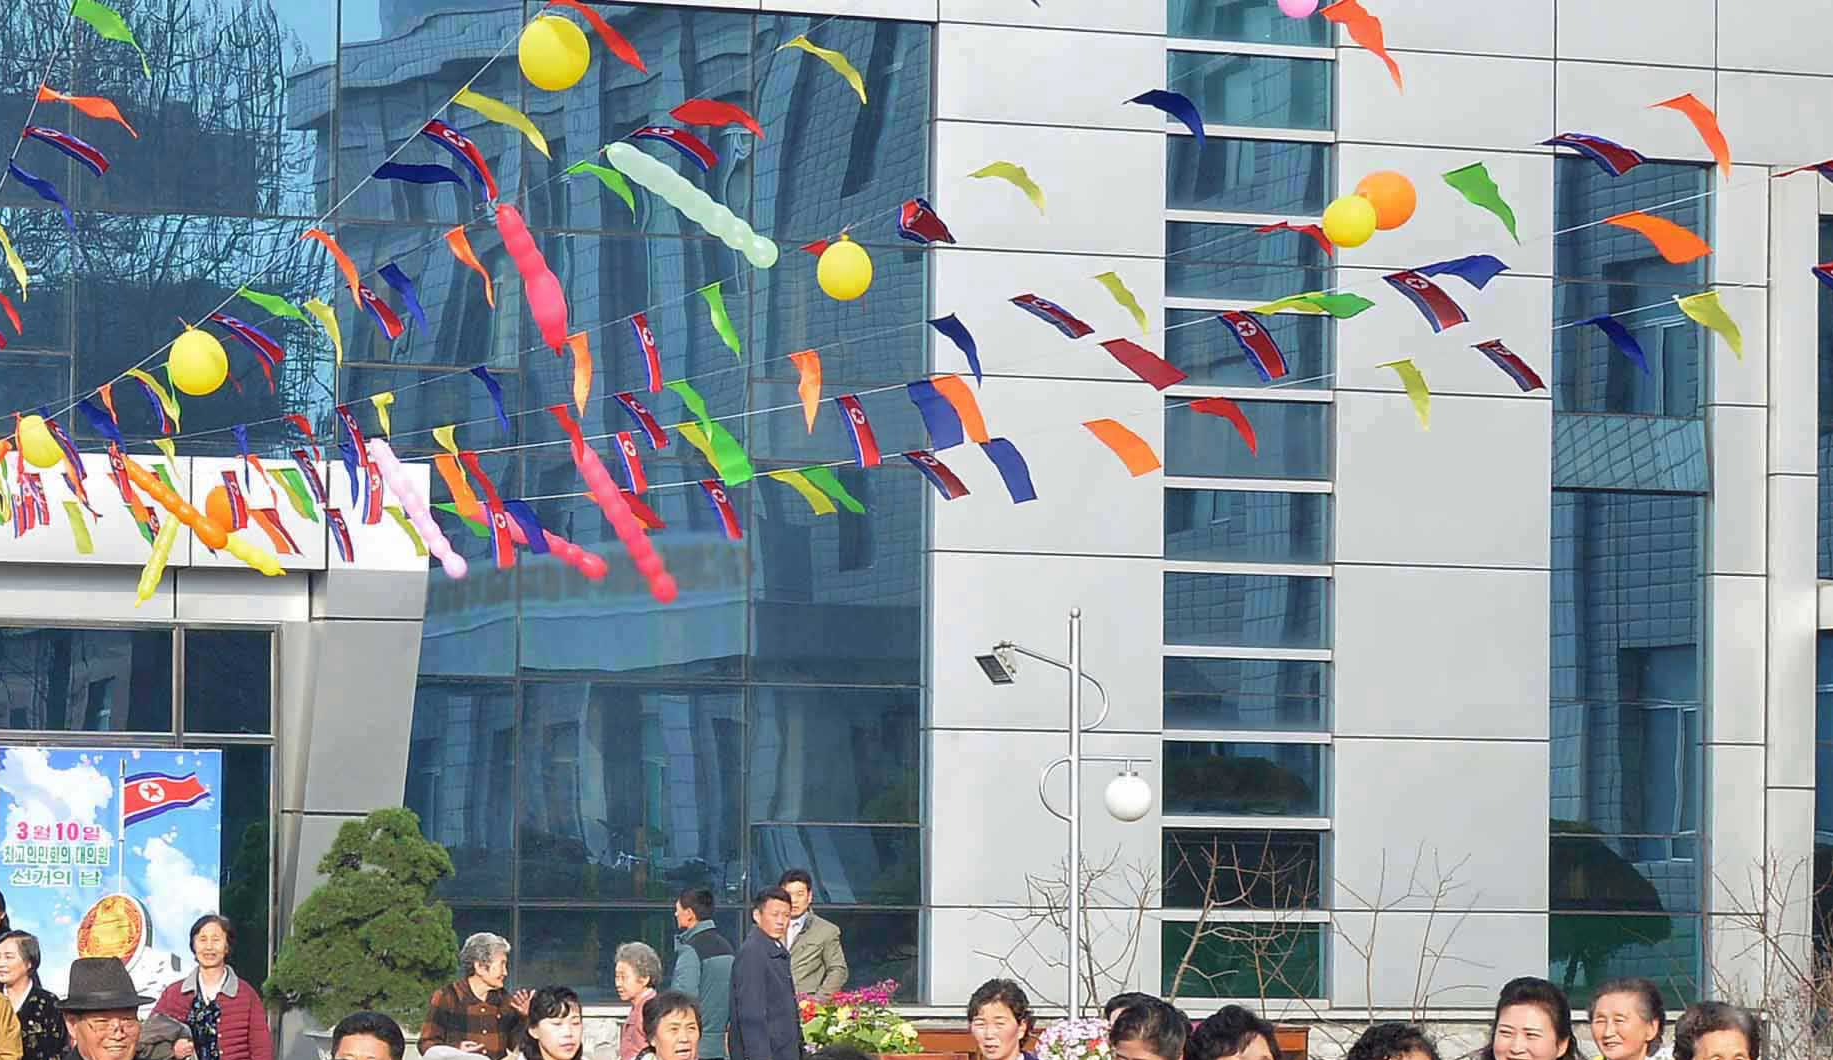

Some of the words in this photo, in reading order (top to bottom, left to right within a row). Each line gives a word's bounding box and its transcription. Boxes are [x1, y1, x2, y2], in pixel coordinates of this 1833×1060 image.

[17, 821, 51, 841] 3월
[56, 822, 101, 841] 10일
[4, 845, 70, 864] 최고인민회의
[75, 845, 109, 865] 대의원
[12, 869, 71, 885] 선거의
[80, 869, 101, 885] 날
